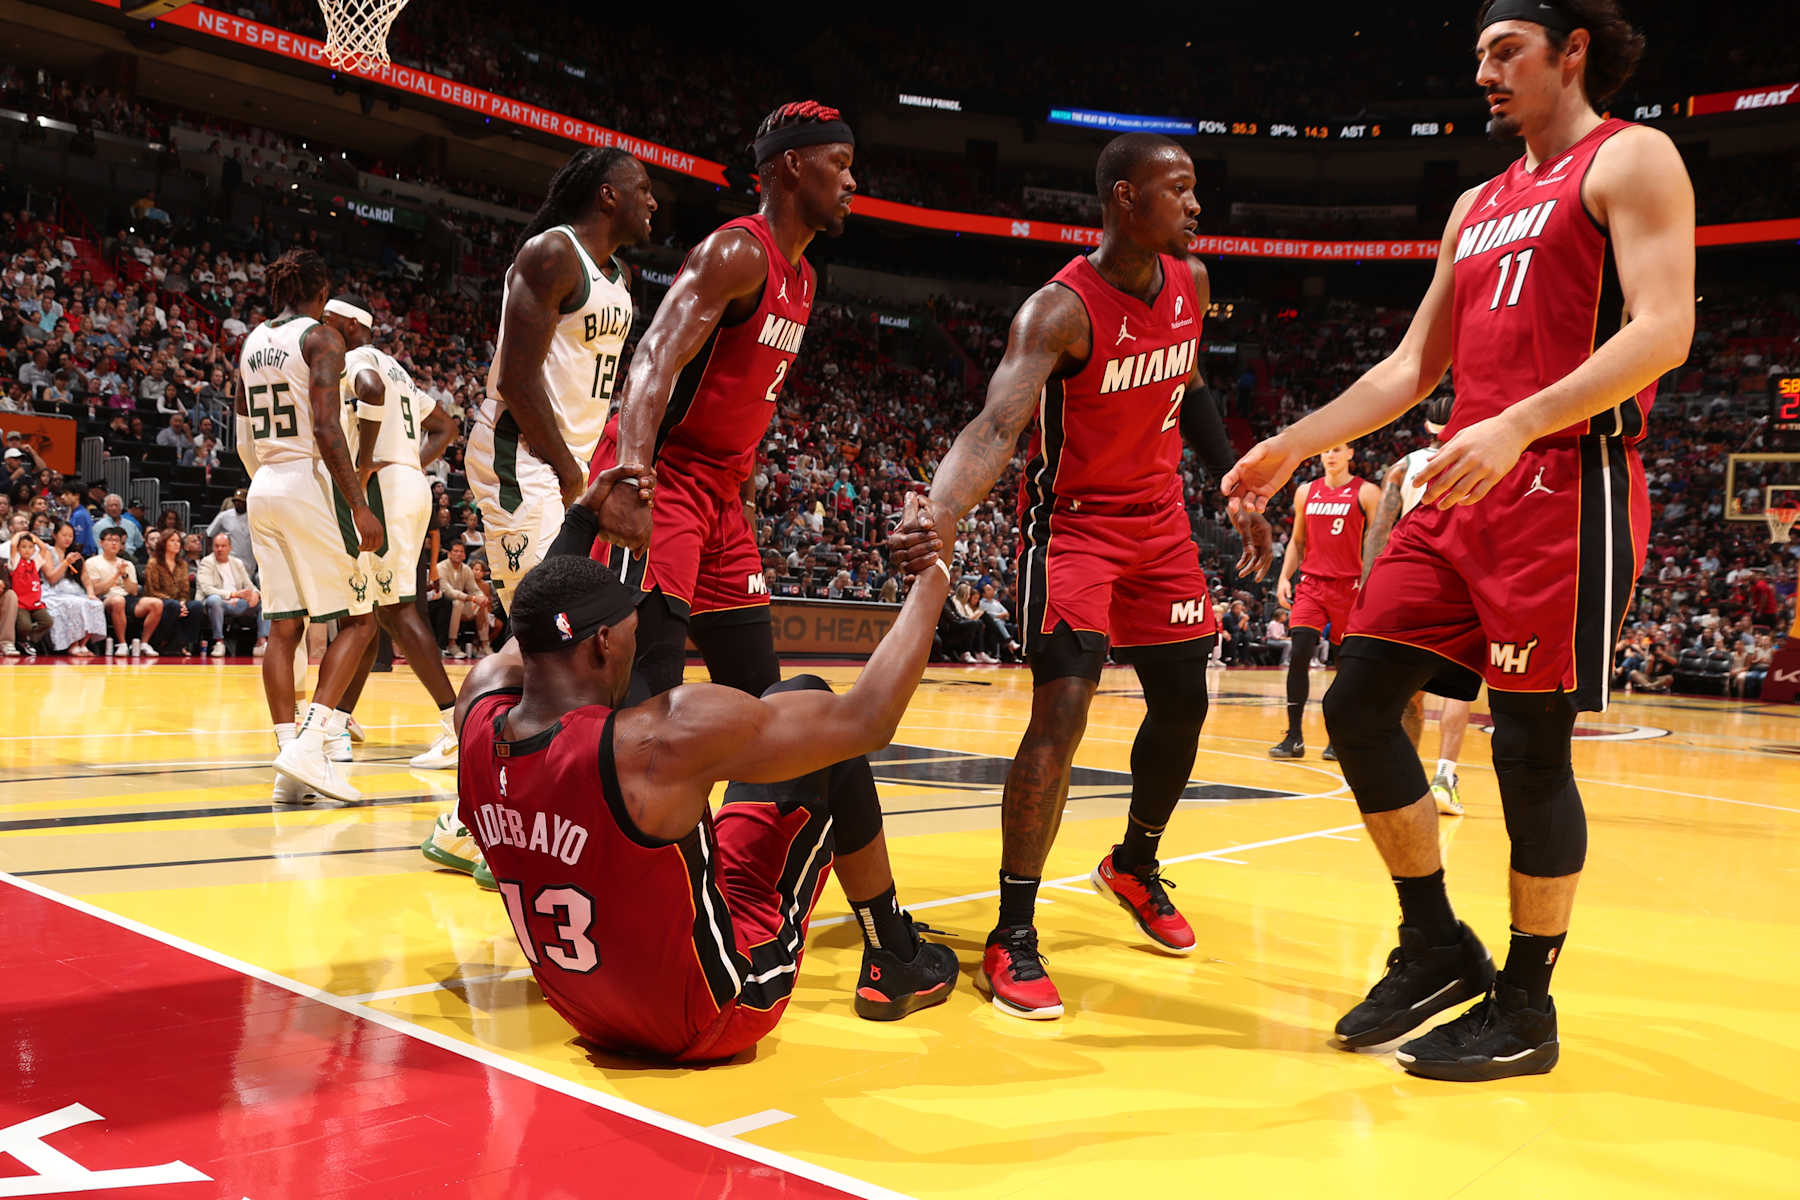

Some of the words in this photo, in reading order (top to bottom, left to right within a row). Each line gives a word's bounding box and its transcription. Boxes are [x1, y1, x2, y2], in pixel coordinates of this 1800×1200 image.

[197, 11, 322, 60] NETSPEND
[441, 82, 488, 109] DEBIT
[491, 98, 559, 131] PARTNER
[563, 120, 583, 137] OF
[586, 126, 612, 148] THE
[616, 136, 659, 161] MIAMI
[662, 151, 695, 172] HEAT
[1634, 104, 1662, 120] FLS
[1672, 102, 1680, 115] 1
[1733, 83, 1799, 111] HEAT
[1198, 120, 1227, 134] FG%
[1270, 123, 1298, 138] 3P%
[1304, 126, 1328, 138] 14.3
[1339, 125, 1366, 138] AST
[1411, 122, 1439, 136] REB
[1061, 228, 1104, 245] NETS
[1187, 238, 1259, 254] OFFICIAL
[1263, 240, 1310, 256] DEBIT
[1313, 243, 1385, 257] PARTNER
[1390, 243, 1412, 257] OF
[1453, 199, 1558, 265] MIAMI
[1488, 247, 1536, 312] 11
[247, 347, 290, 374] WRIGHT
[591, 353, 618, 400] 12
[765, 360, 788, 402] 2
[1099, 337, 1197, 394] MIAMI
[249, 382, 299, 440] 55
[400, 395, 416, 440] 9
[1160, 382, 1186, 433] 2
[1306, 502, 1352, 516] MIAMI
[1330, 517, 1345, 536] 9
[815, 615, 891, 644] HEAT
[473, 803, 589, 866] ADEBAYO
[497, 880, 602, 975] 13
